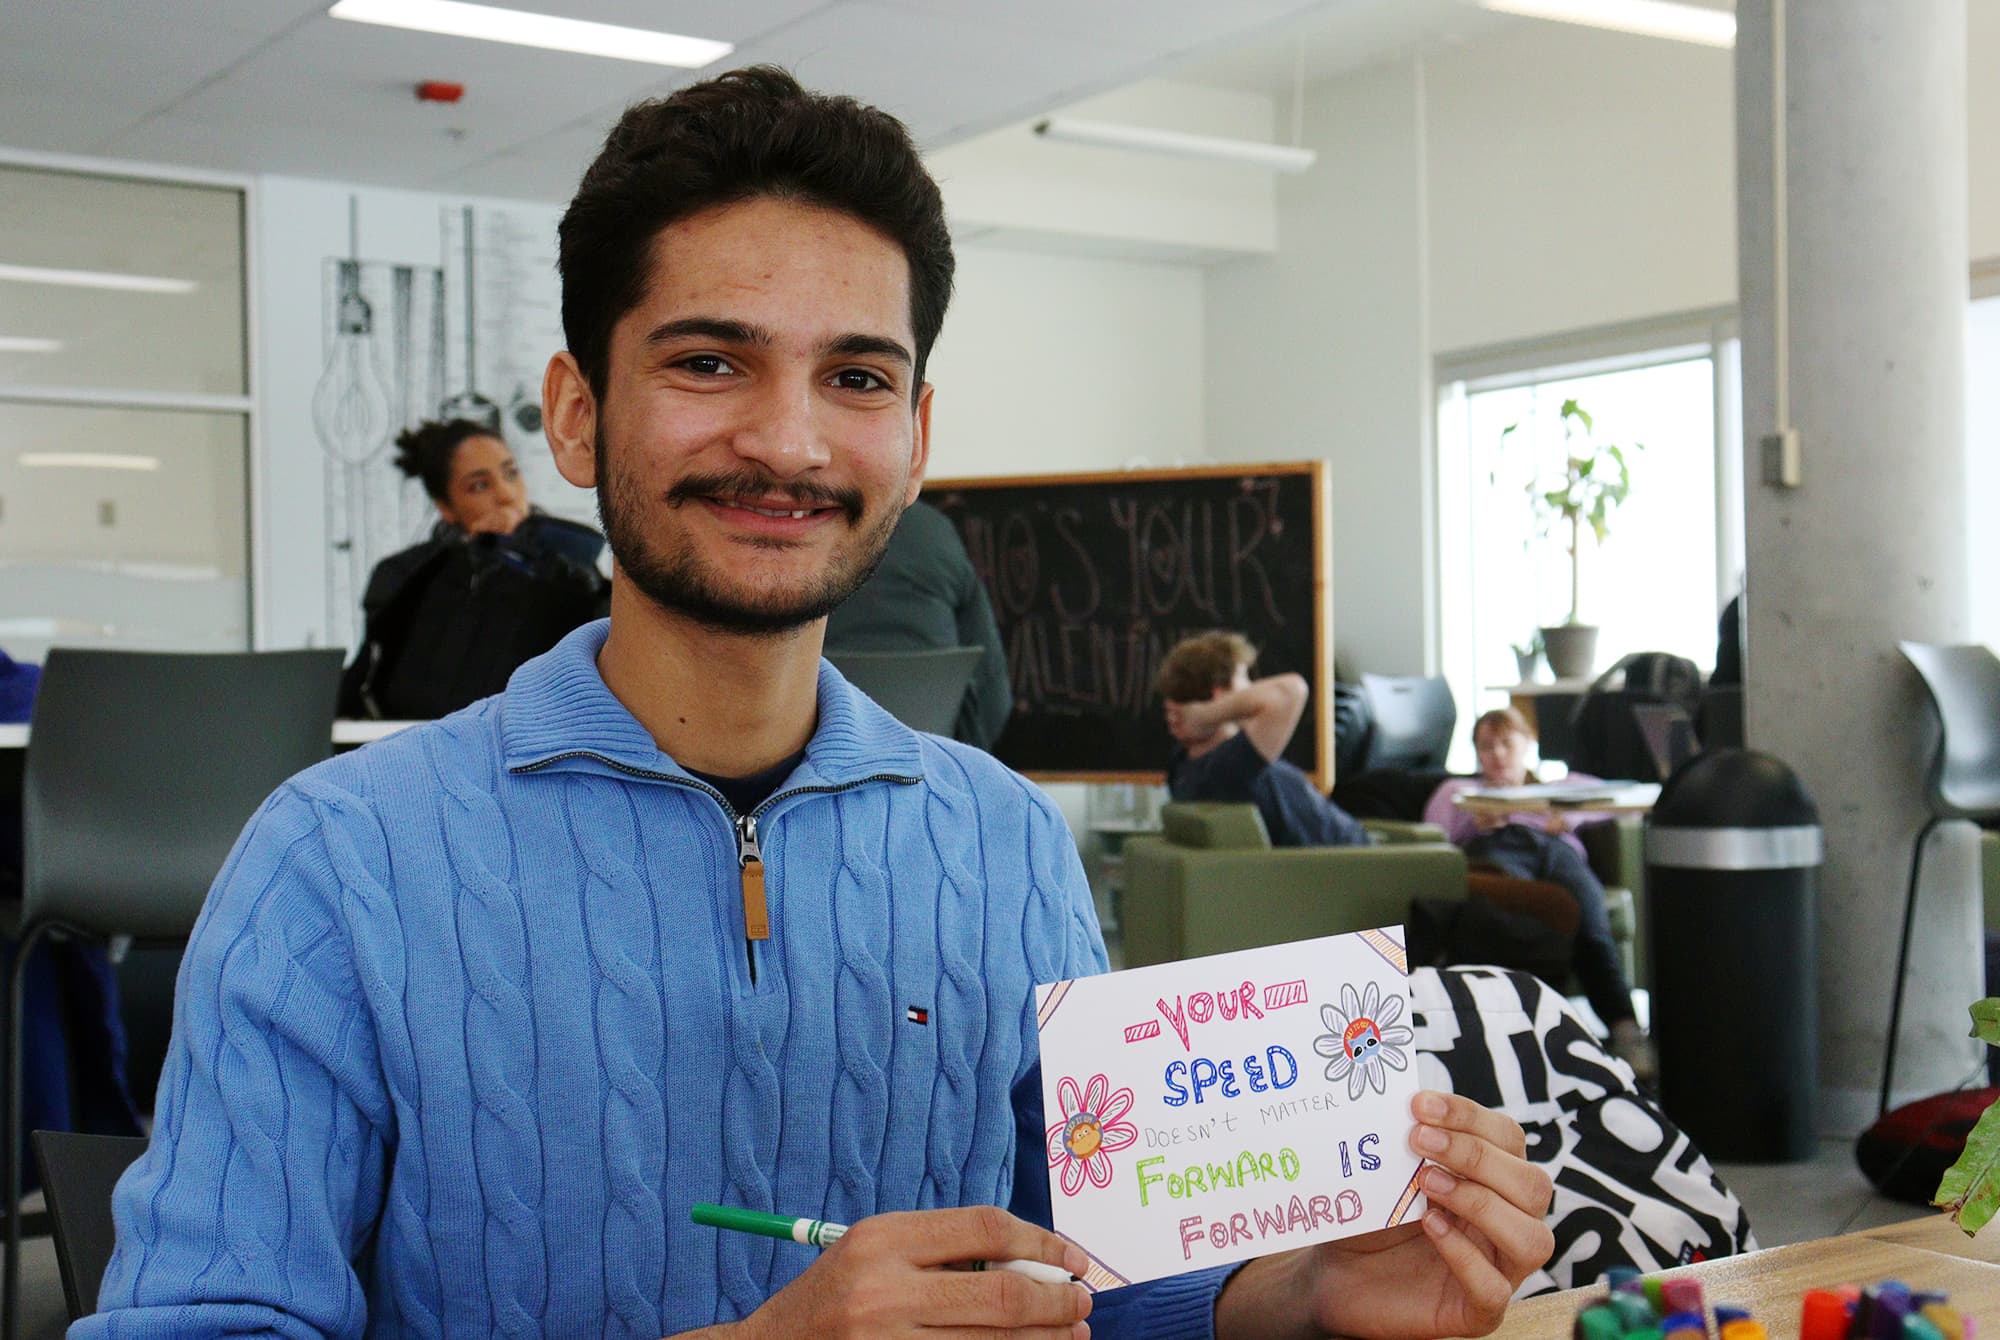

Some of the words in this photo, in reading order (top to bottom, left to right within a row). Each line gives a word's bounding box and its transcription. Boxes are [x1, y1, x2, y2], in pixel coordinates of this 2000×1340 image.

[1109, 494, 1286, 627] YOUR
[1156, 981, 1264, 1052] YOUR
[1163, 1046, 1298, 1107] SPEED
[1260, 1093, 1339, 1126] MATTER
[1136, 1148, 1300, 1208] FORWARD
[1338, 1134, 1381, 1178] IS
[1179, 1190, 1363, 1260] FORWARD
